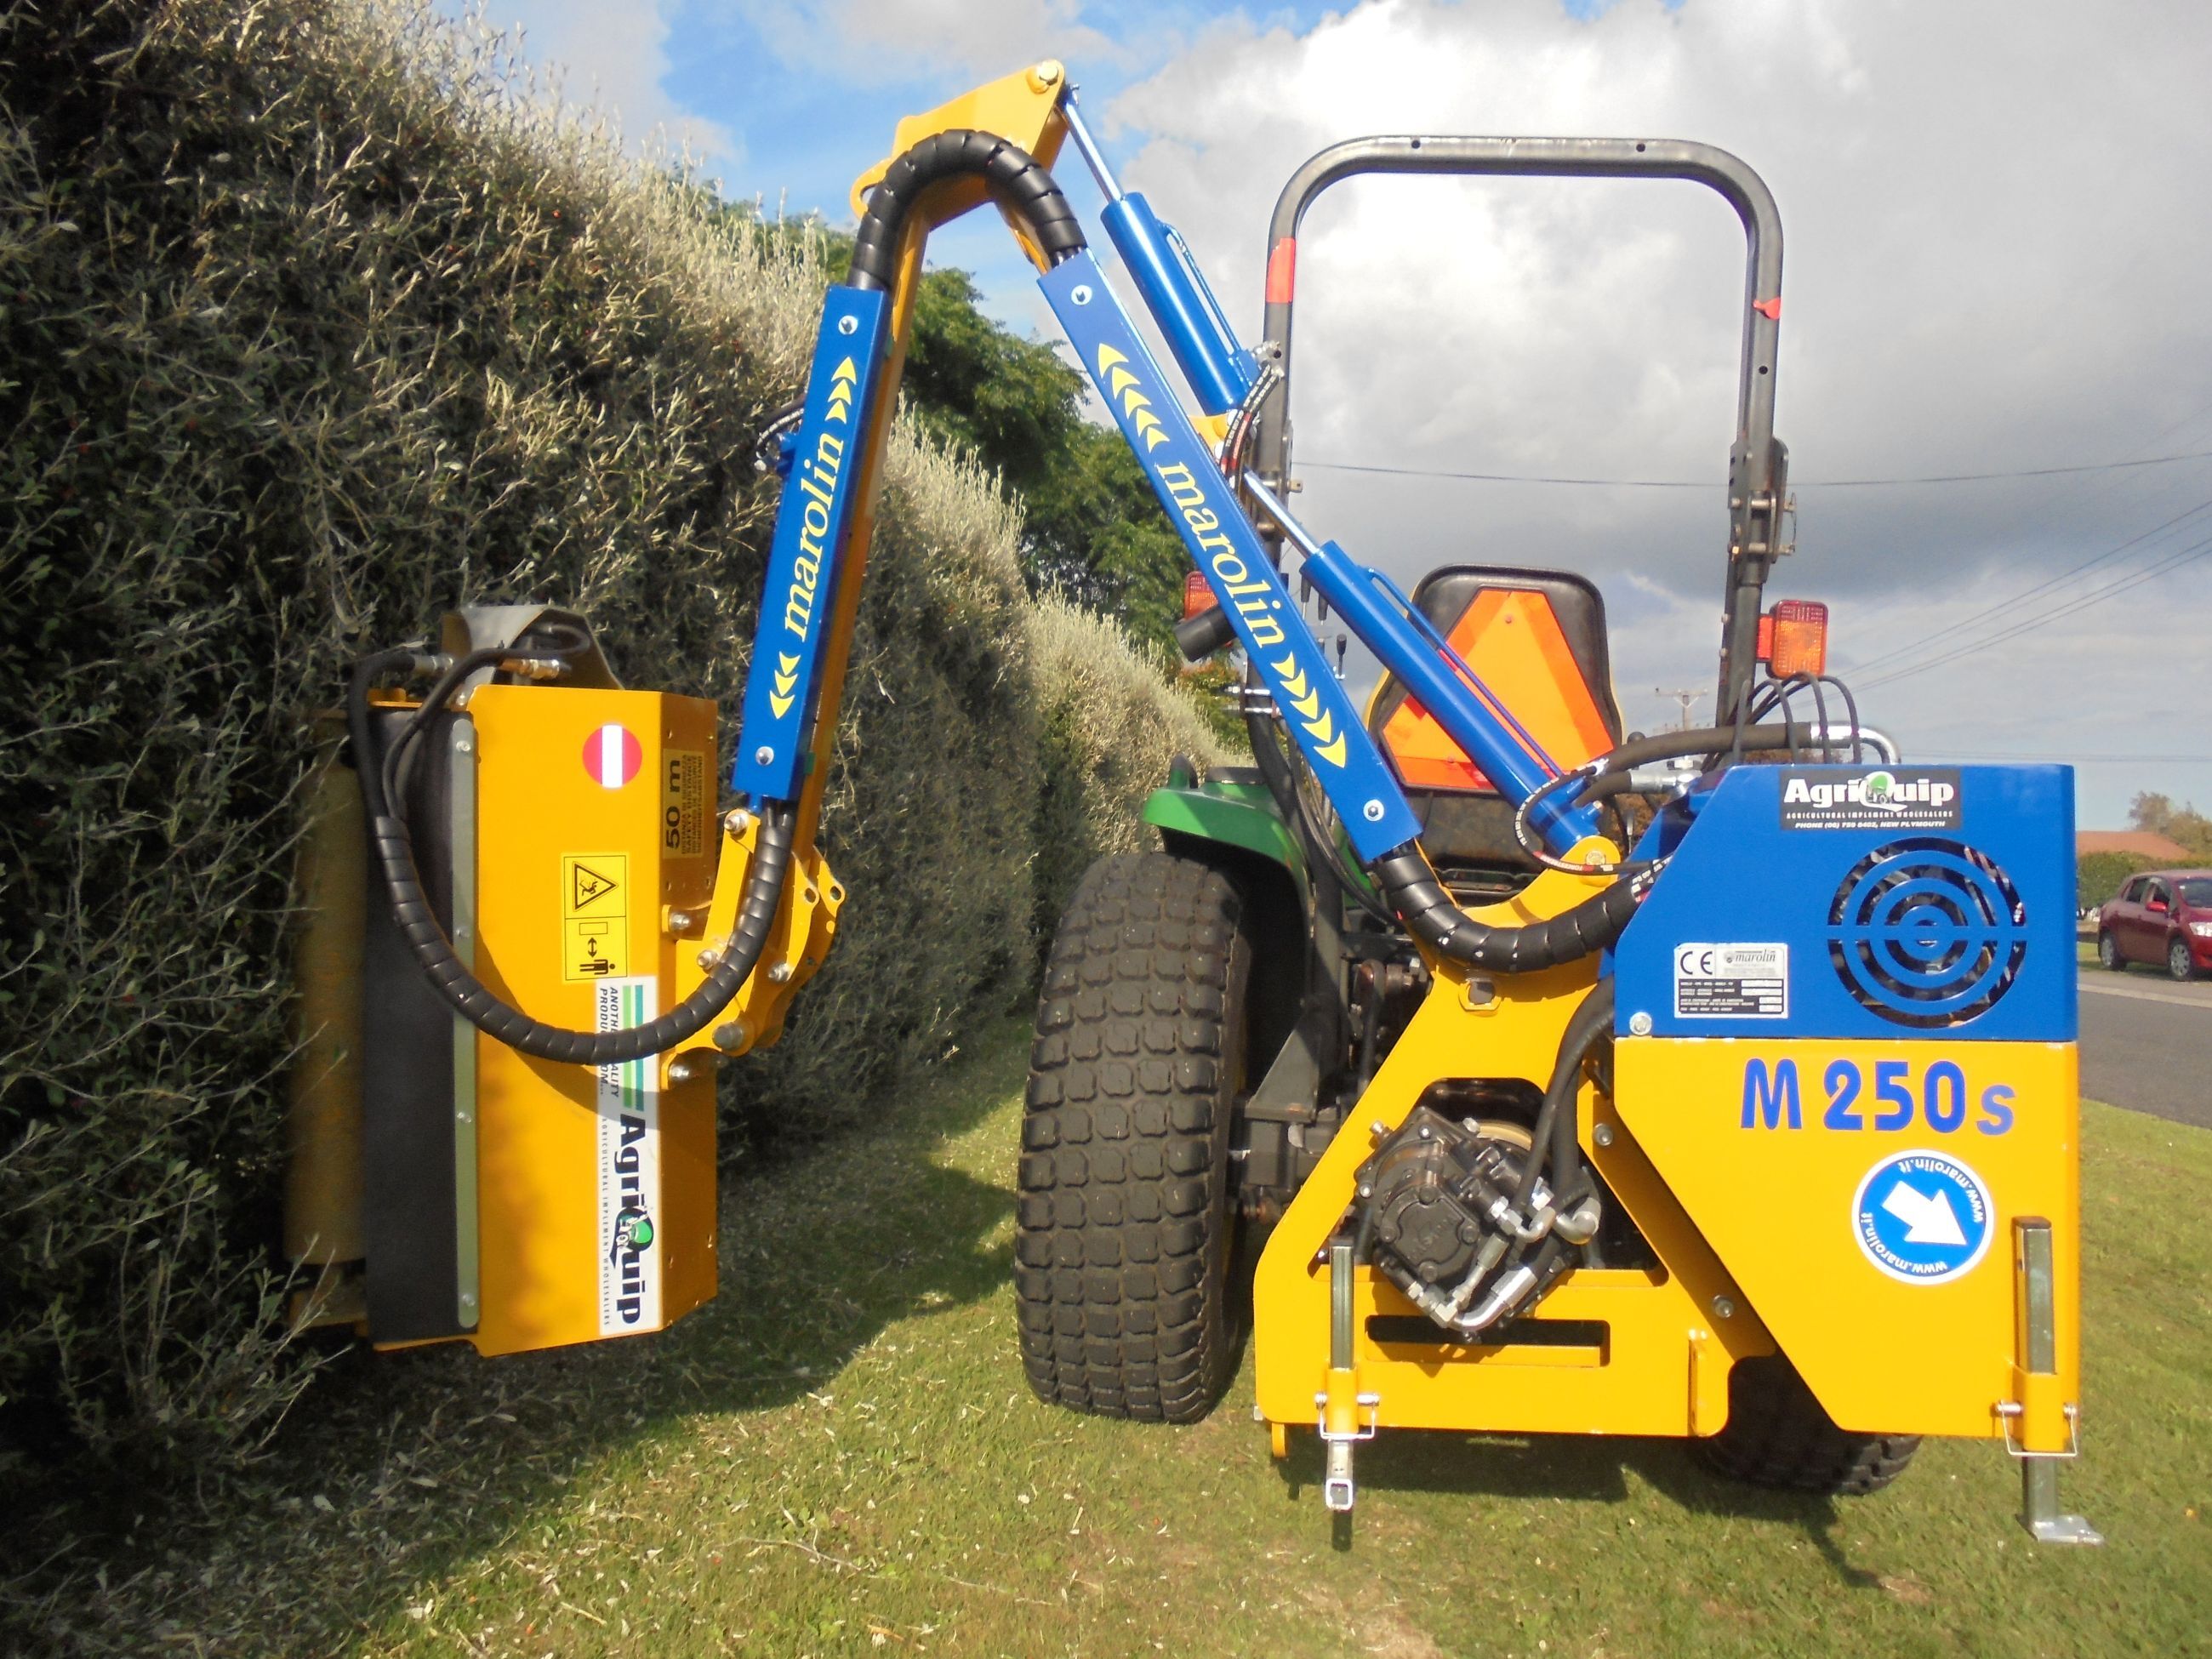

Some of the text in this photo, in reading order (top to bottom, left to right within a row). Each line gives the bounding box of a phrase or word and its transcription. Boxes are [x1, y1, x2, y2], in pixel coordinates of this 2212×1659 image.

[784, 432, 844, 642] marolin
[1155, 459, 1286, 649] marolin
[665, 760, 680, 849] 50 m
[1784, 771, 1954, 812] AgriQuip
[1736, 949, 1776, 962] marolin
[1741, 1058, 1802, 1130] M
[609, 1114, 653, 1324] AgriQuip
[1898, 1159, 1983, 1223] www.marolin.it
[1861, 1212, 1947, 1274] www.marolin.it
